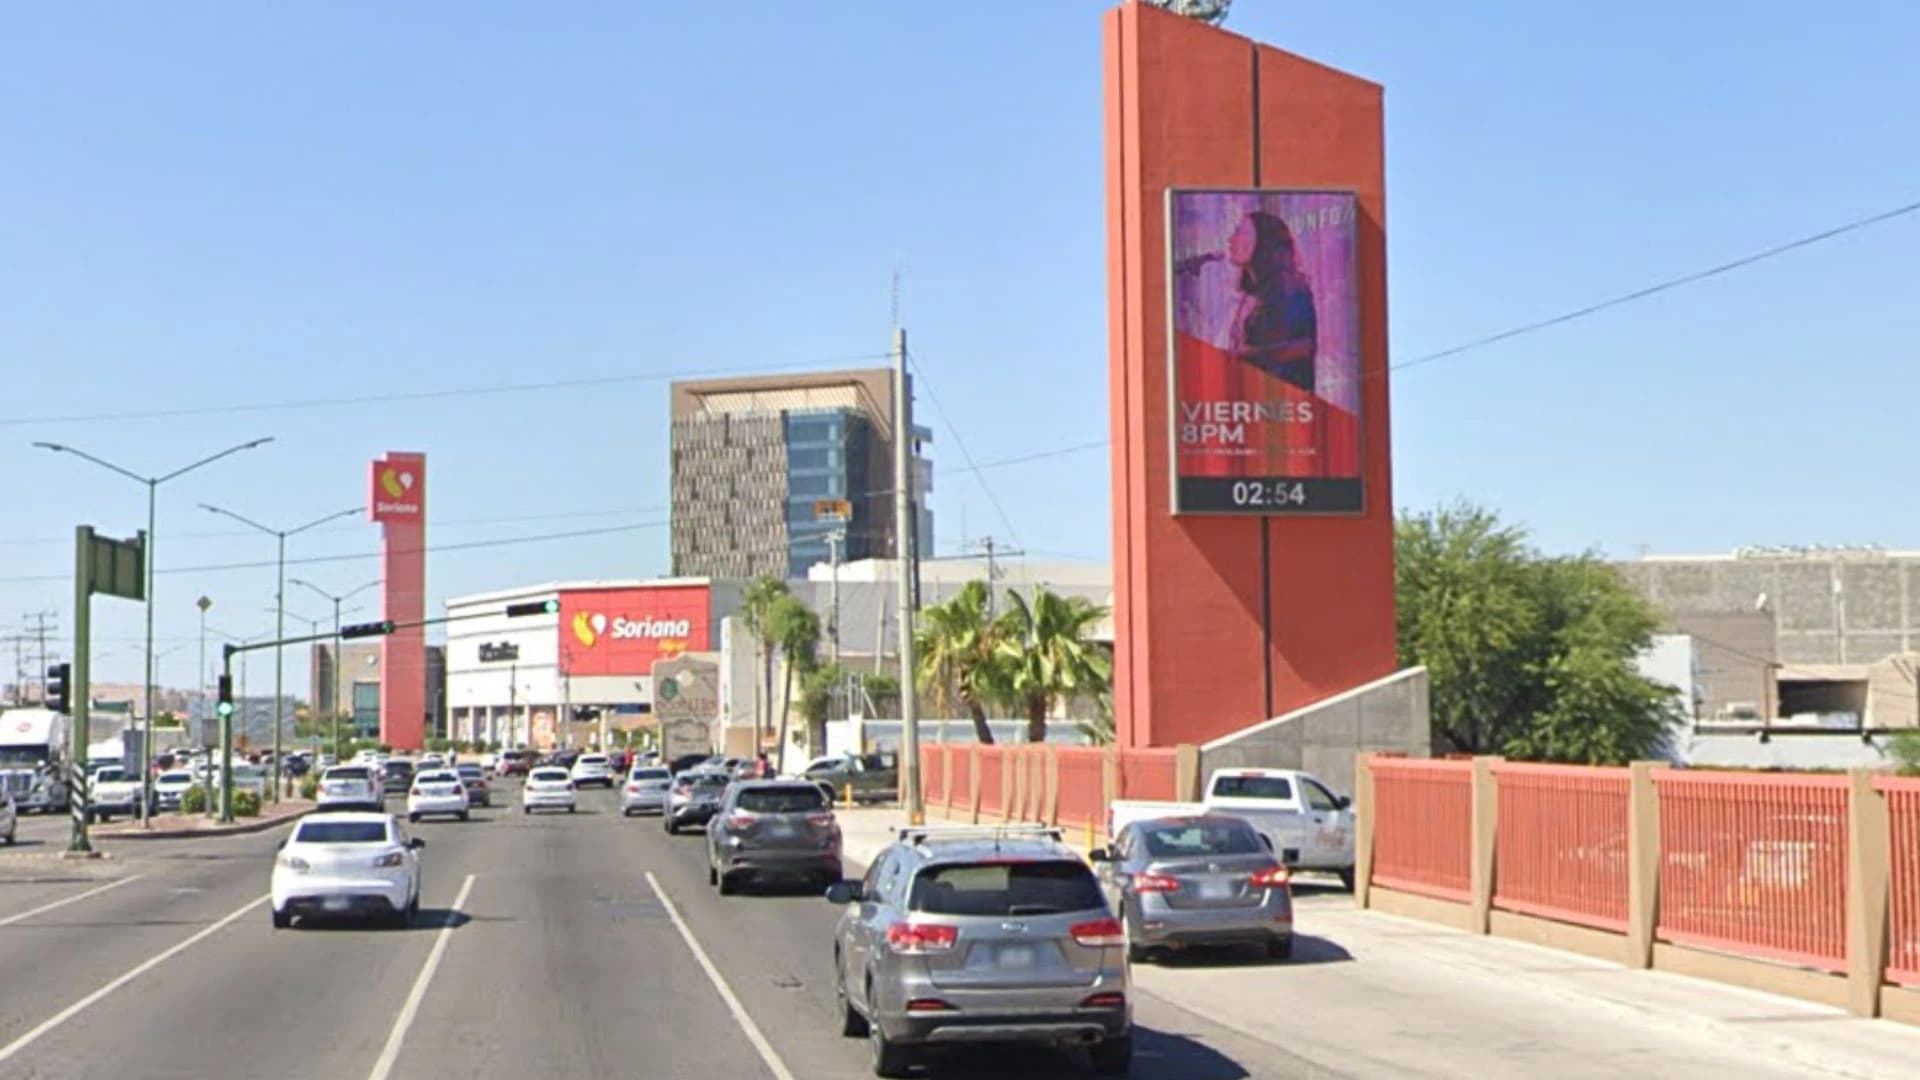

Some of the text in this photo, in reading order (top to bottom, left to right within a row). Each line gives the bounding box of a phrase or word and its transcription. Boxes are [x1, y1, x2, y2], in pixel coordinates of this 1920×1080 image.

[1181, 401, 1314, 423] VIERNES
[1182, 424, 1244, 444] 8PM
[1232, 482, 1306, 505] 02:54
[376, 502, 419, 513] Soriana
[611, 616, 690, 639] Soriana
